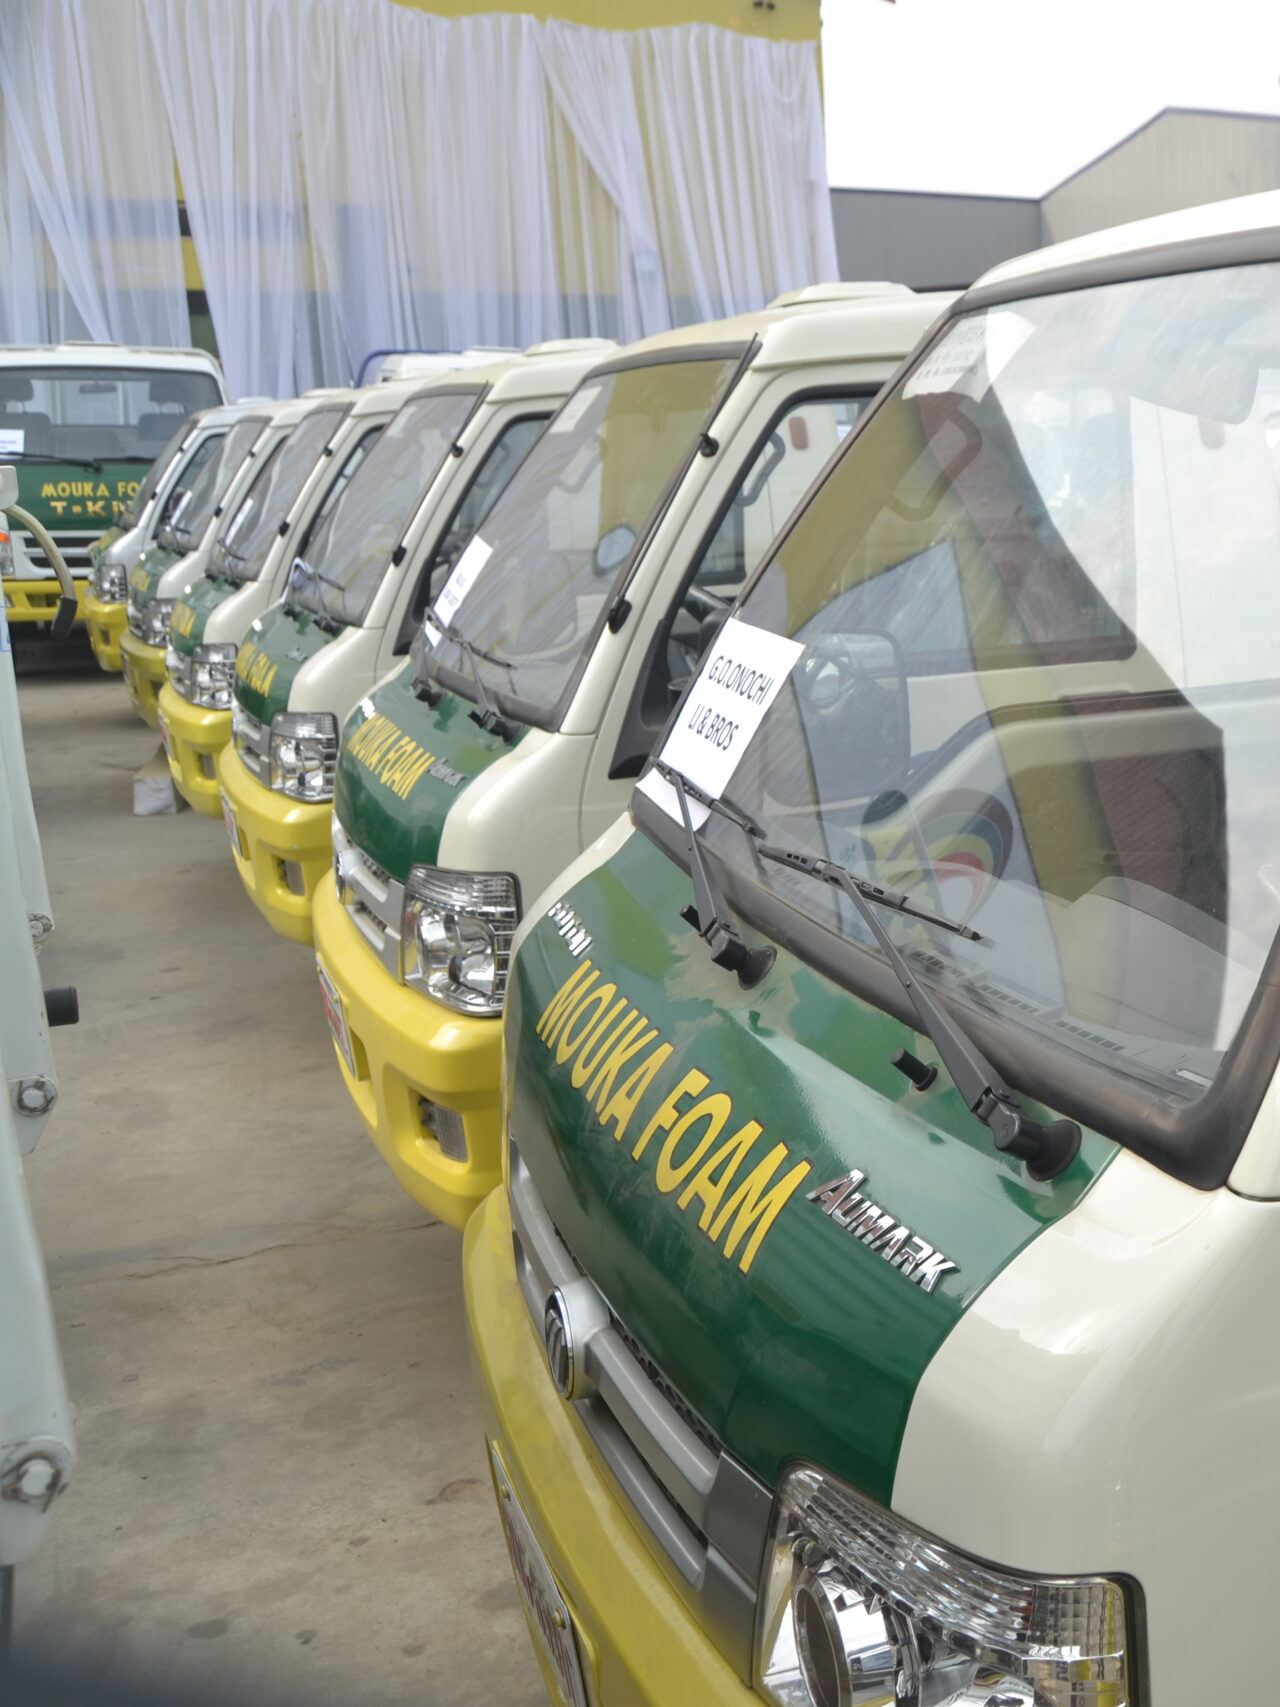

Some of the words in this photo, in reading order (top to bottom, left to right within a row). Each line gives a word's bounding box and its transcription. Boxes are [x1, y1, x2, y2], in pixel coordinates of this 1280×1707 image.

[41, 482, 110, 498] MOUKA
[708, 655, 775, 705] G.O.ONOCHI
[696, 707, 712, 736] &
[704, 713, 739, 751] BROS
[375, 735, 437, 800] FOAM
[535, 959, 674, 1142] MOUKA
[631, 1067, 814, 1276] FOAM
[805, 1168, 961, 1294] AUMARK
